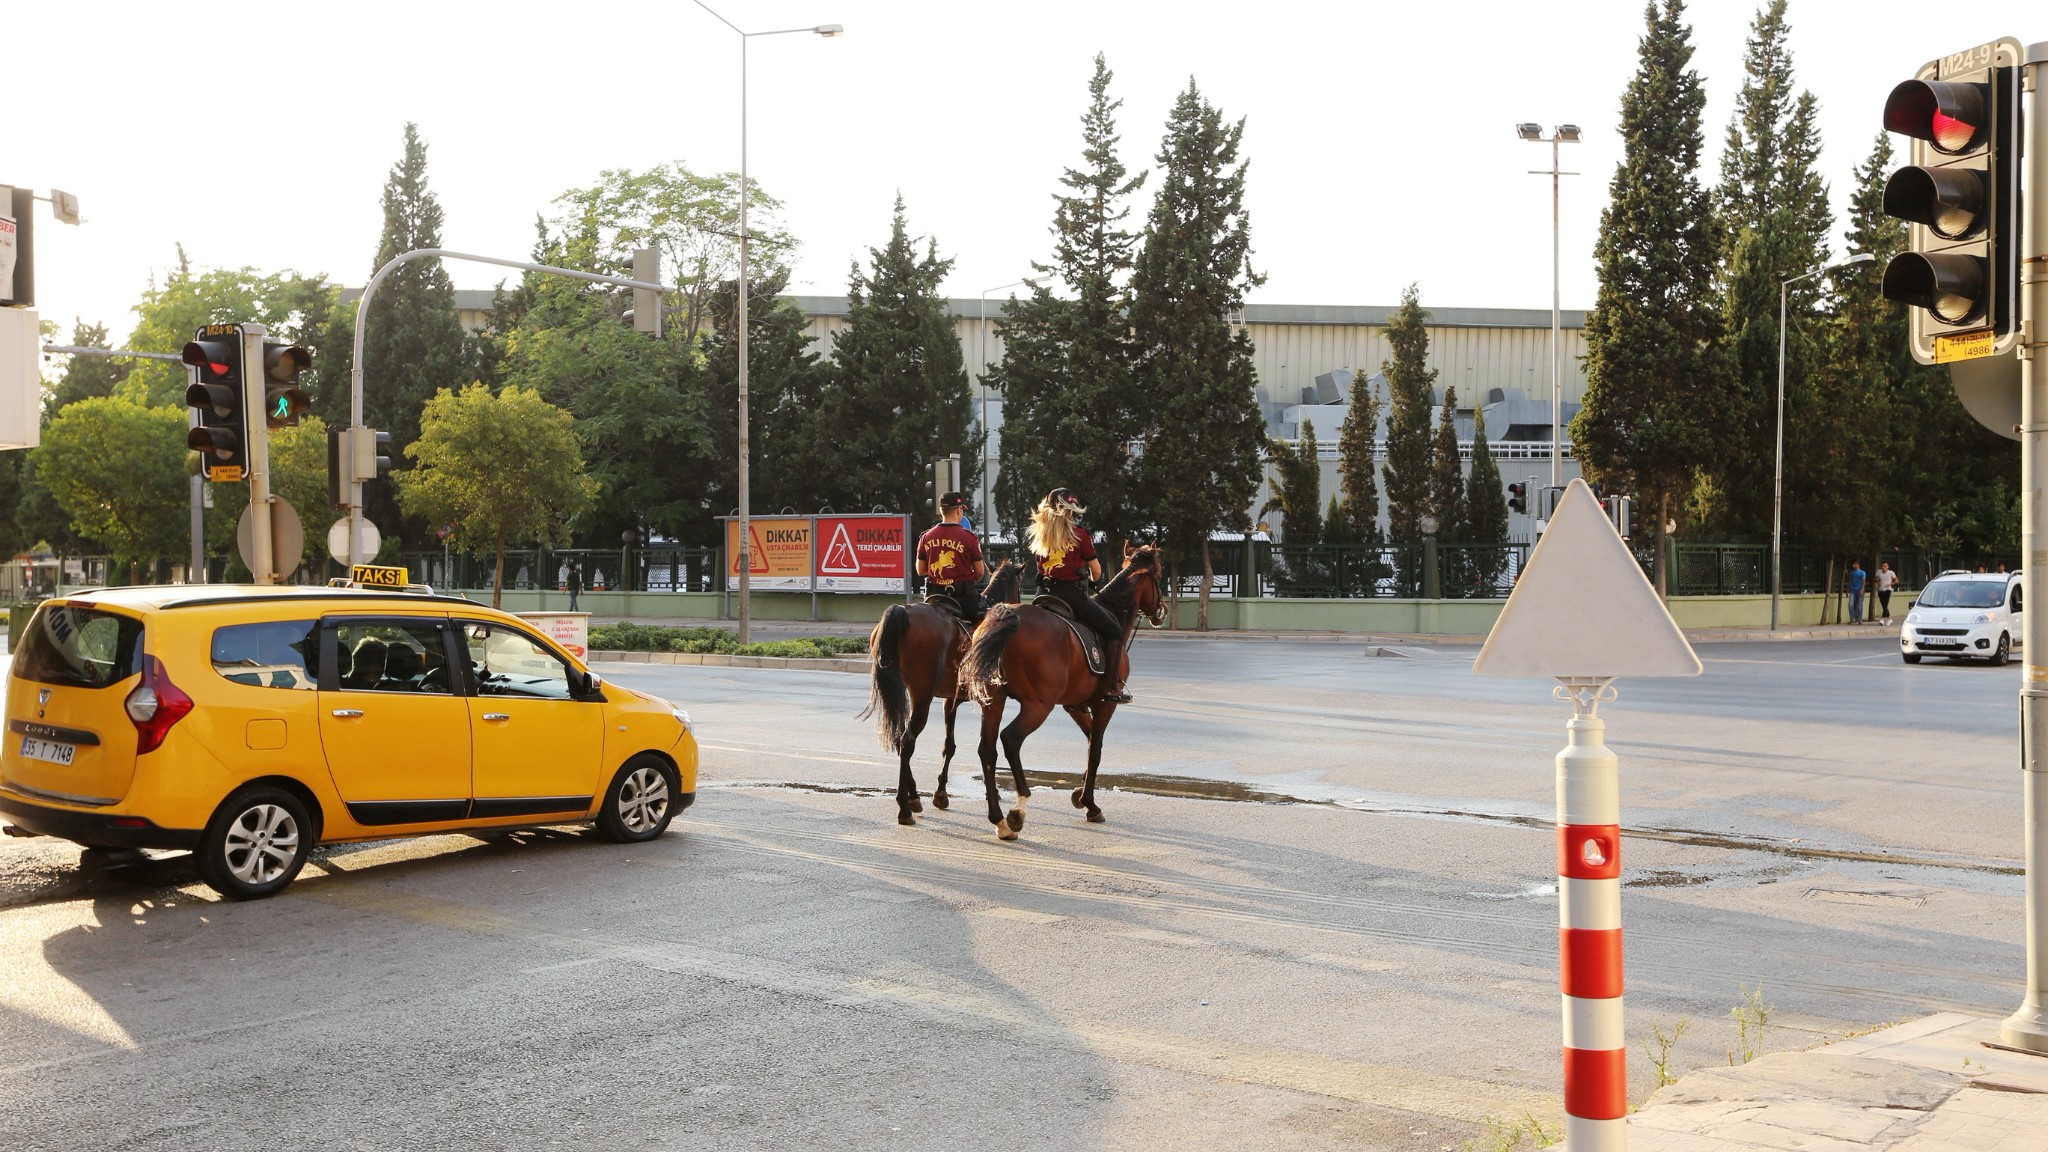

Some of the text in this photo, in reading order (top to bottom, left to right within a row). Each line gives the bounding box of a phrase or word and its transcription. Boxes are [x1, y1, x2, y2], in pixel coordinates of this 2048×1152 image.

[1938, 44, 1991, 77] M24-9
[766, 544, 781, 552] USTA
[856, 542, 902, 553] TERZİ ÇIKABİLİR
[924, 538, 965, 554] ATLI POLİS
[25, 740, 73, 762] 35 T 7148
